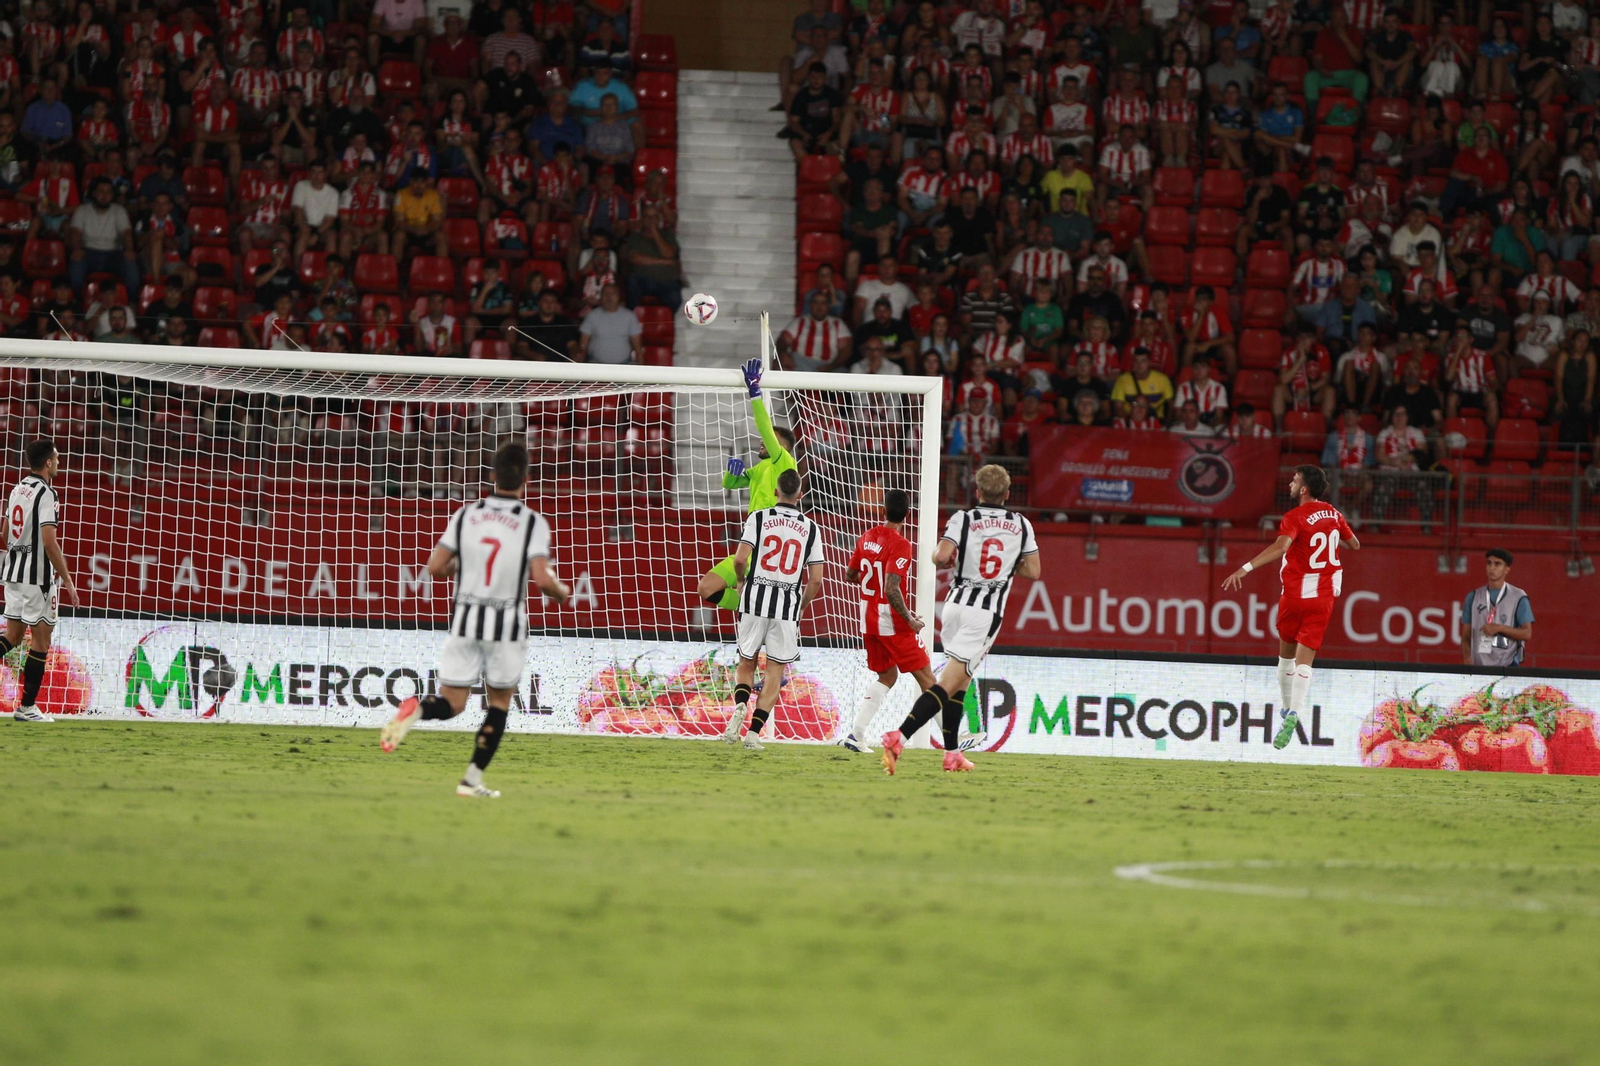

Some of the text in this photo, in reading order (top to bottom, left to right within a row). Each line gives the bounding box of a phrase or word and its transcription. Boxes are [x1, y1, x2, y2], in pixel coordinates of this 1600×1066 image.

[11, 504, 24, 540] 9
[763, 518, 808, 538] SEUNTJENS
[969, 518, 1023, 536] VAN DEN BELT
[480, 537, 502, 587] 7
[760, 534, 802, 576] 20
[979, 537, 1004, 580] 6
[1308, 528, 1341, 570] 20
[860, 557, 884, 599] 21
[51, 595, 57, 611] 9
[1015, 579, 1462, 645] Automot Cost
[240, 661, 554, 716] MERCOL
